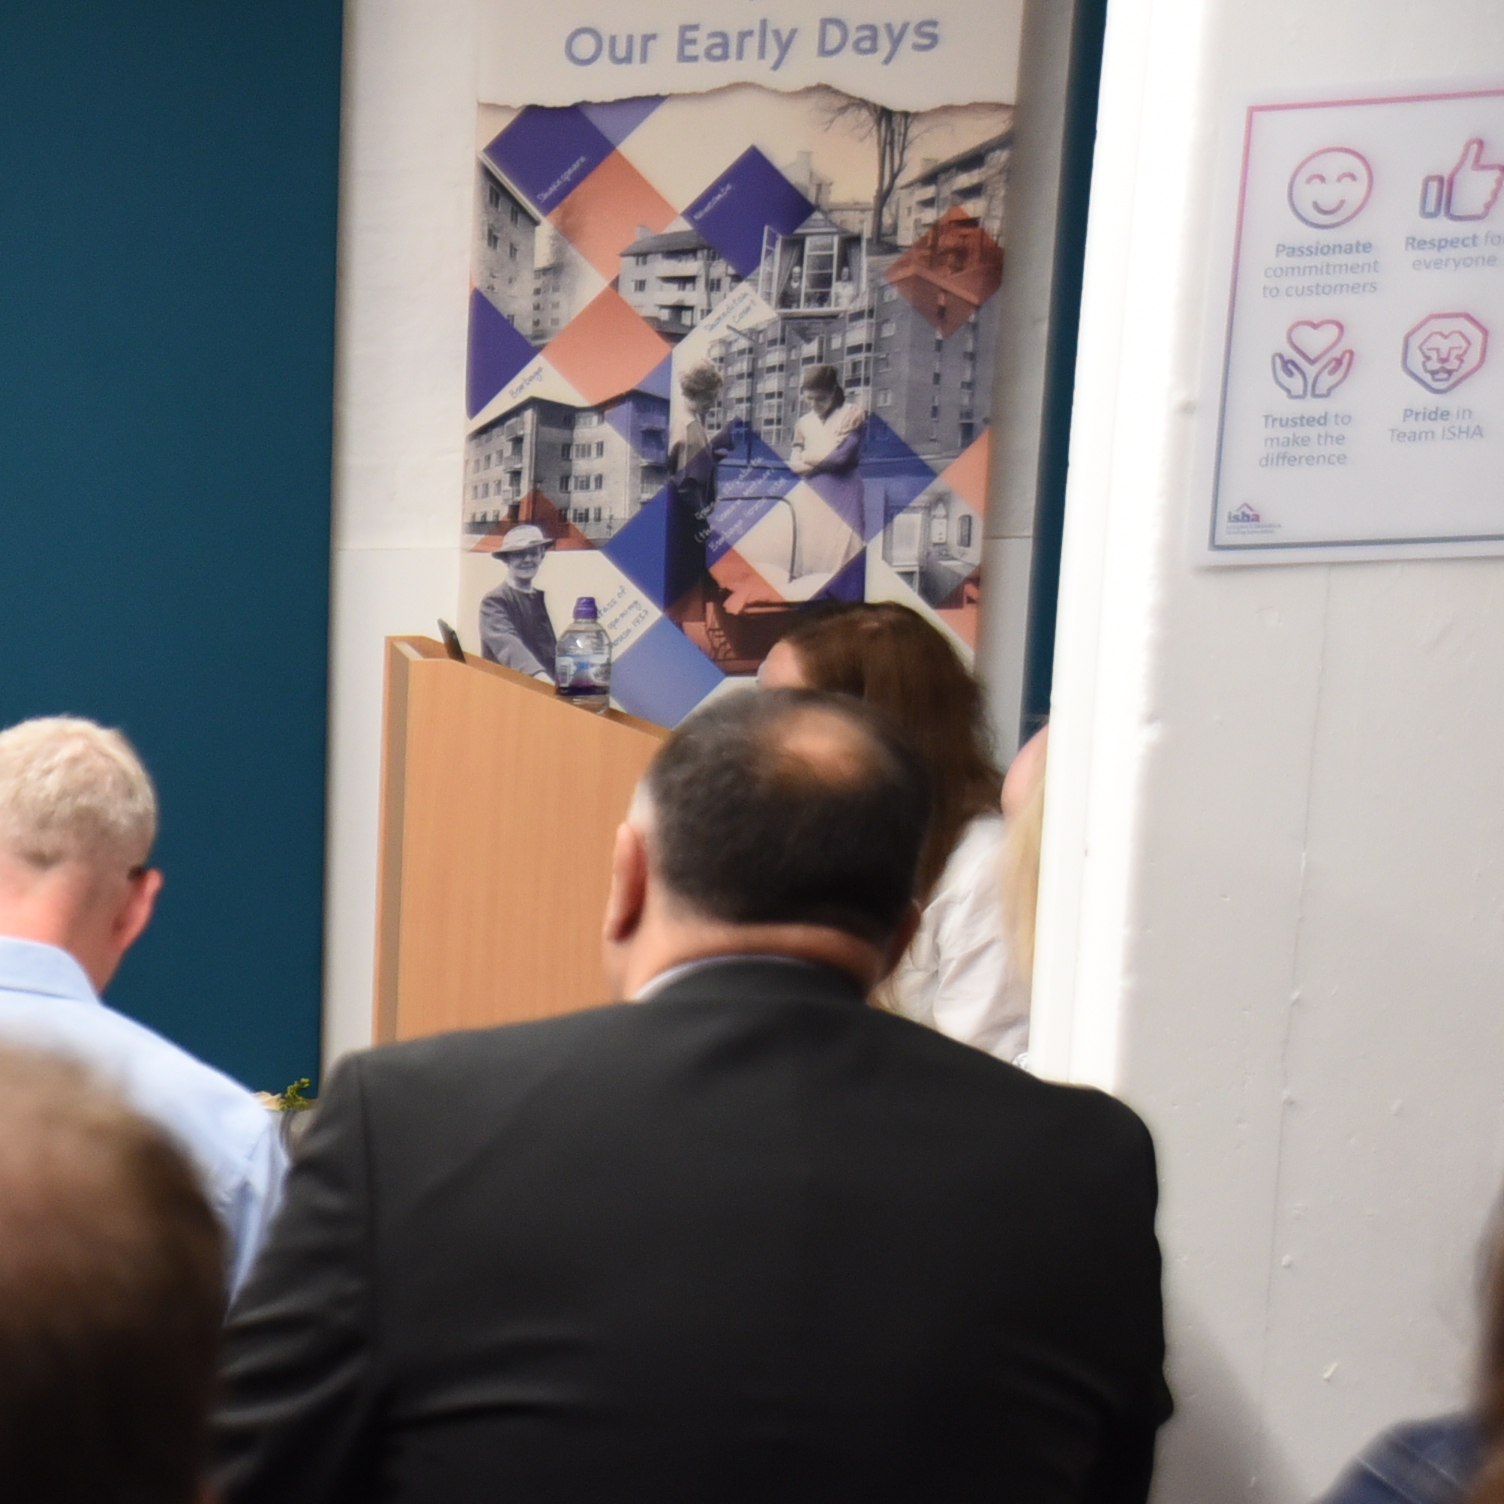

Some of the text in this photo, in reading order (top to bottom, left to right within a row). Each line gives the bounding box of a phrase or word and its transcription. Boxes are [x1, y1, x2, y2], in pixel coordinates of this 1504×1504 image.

[564, 17, 940, 72] Our Early Days
[1276, 241, 1373, 258] Passionate
[1405, 230, 1504, 252] Respect fo
[1264, 260, 1379, 278] commitment
[1412, 254, 1497, 272] everyone
[1263, 280, 1378, 298] to customers
[1262, 412, 1352, 428] Trusted to
[1402, 406, 1472, 423] Pride in
[1264, 431, 1346, 448] make the
[1388, 425, 1485, 443] Team ISHA
[1259, 452, 1347, 468] difference
[1227, 511, 1261, 524] isha
